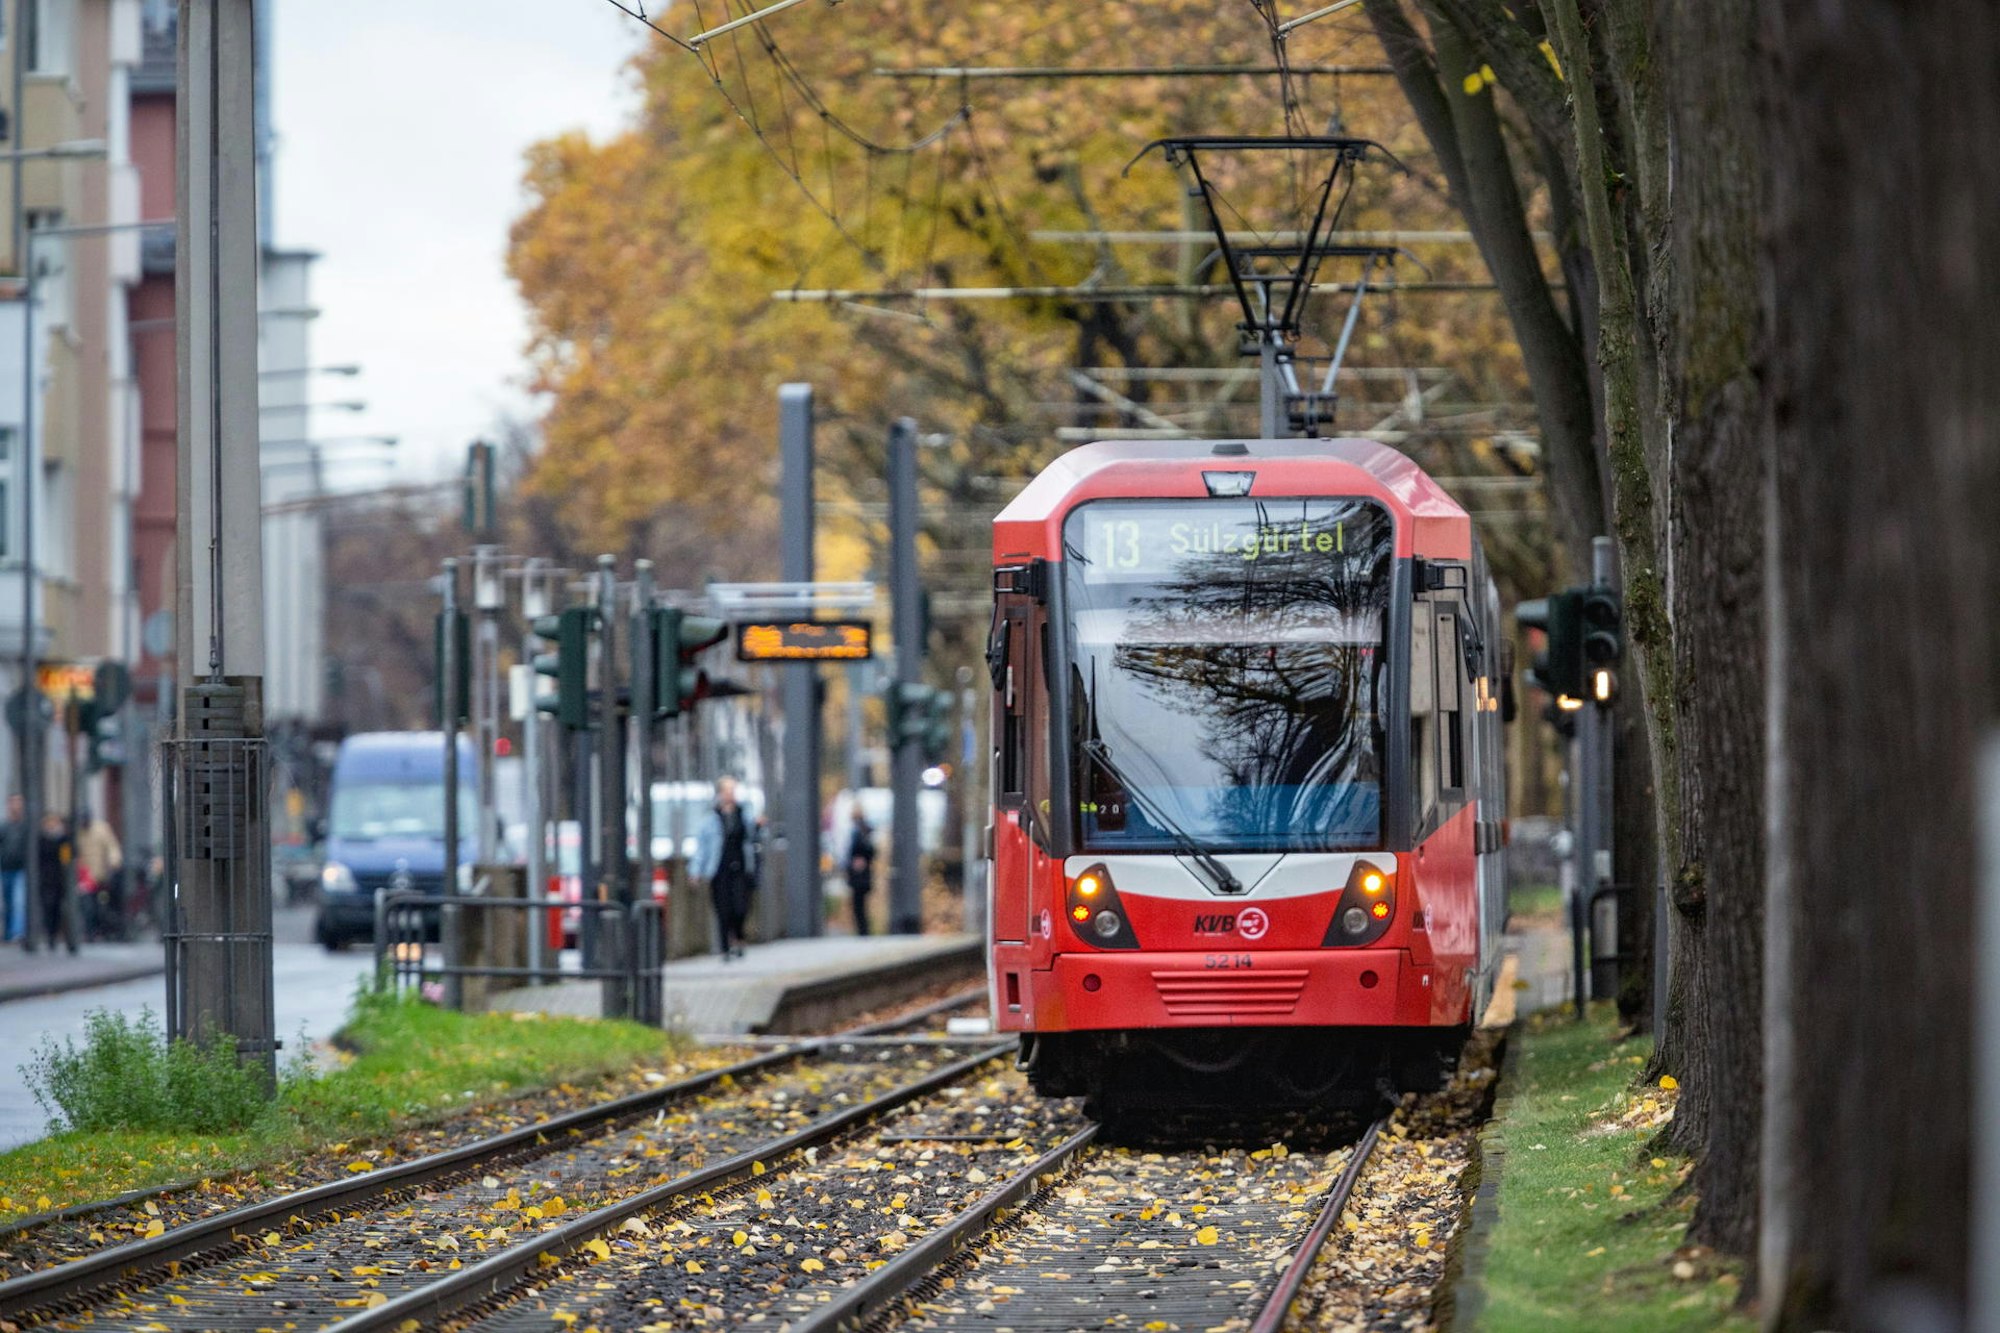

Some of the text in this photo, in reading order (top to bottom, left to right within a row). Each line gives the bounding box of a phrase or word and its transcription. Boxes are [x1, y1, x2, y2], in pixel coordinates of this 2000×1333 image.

[1103, 519, 1343, 568] 13 Sülzgürtel
[1194, 915, 1235, 933] KVB
[1205, 954, 1252, 968] 5214
